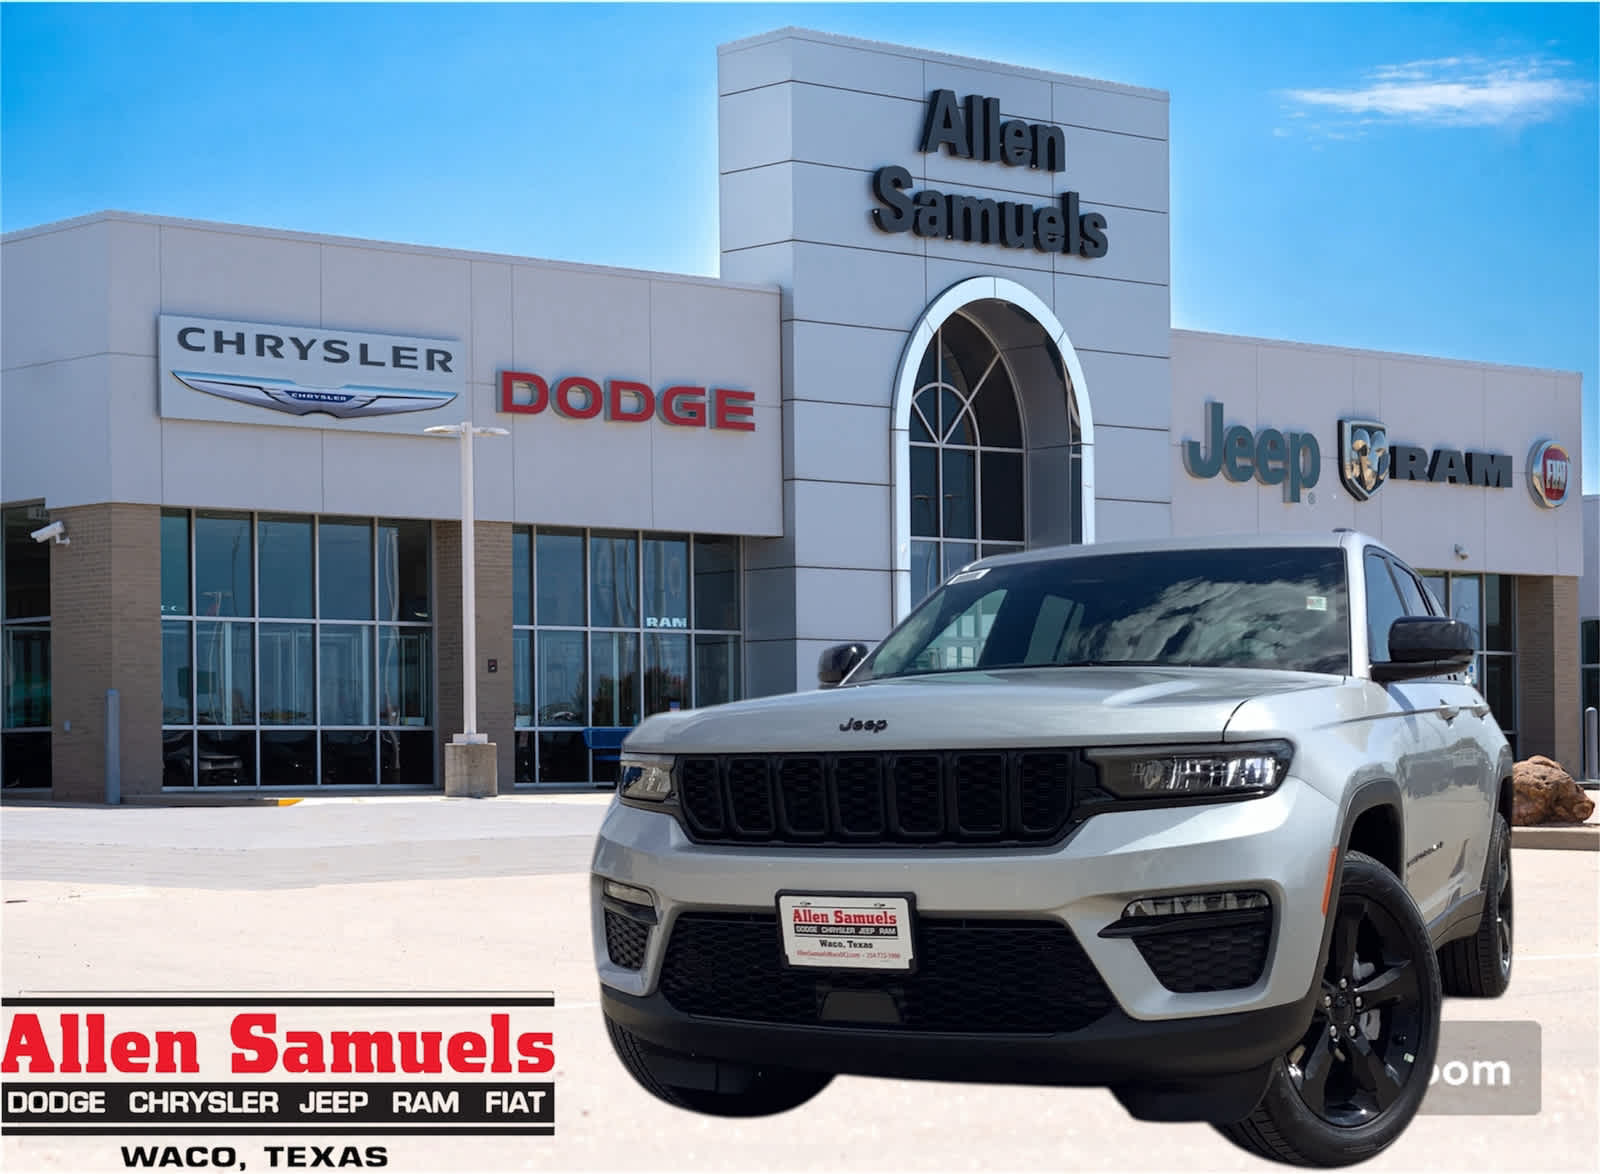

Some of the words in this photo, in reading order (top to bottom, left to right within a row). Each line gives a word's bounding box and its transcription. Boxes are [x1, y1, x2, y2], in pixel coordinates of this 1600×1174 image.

[918, 88, 1066, 172] Allen
[872, 165, 1109, 259] Samuels
[177, 326, 454, 373] CHRYSLER
[291, 392, 347, 401] CHRYSLER
[496, 370, 756, 433] DODGE
[1182, 401, 1321, 503] Jeep
[1388, 445, 1513, 489] RAM
[1546, 459, 1567, 489] FIAT
[646, 616, 688, 628] RAM
[839, 717, 888, 734] Jeep
[793, 908, 830, 923] Allen
[833, 909, 897, 925] Samuels
[796, 925, 818, 934] DODGE
[821, 926, 856, 935] CHRYSLER
[858, 927, 876, 935] JEEP
[879, 927, 897, 936] RAM
[846, 940, 874, 949] Texas
